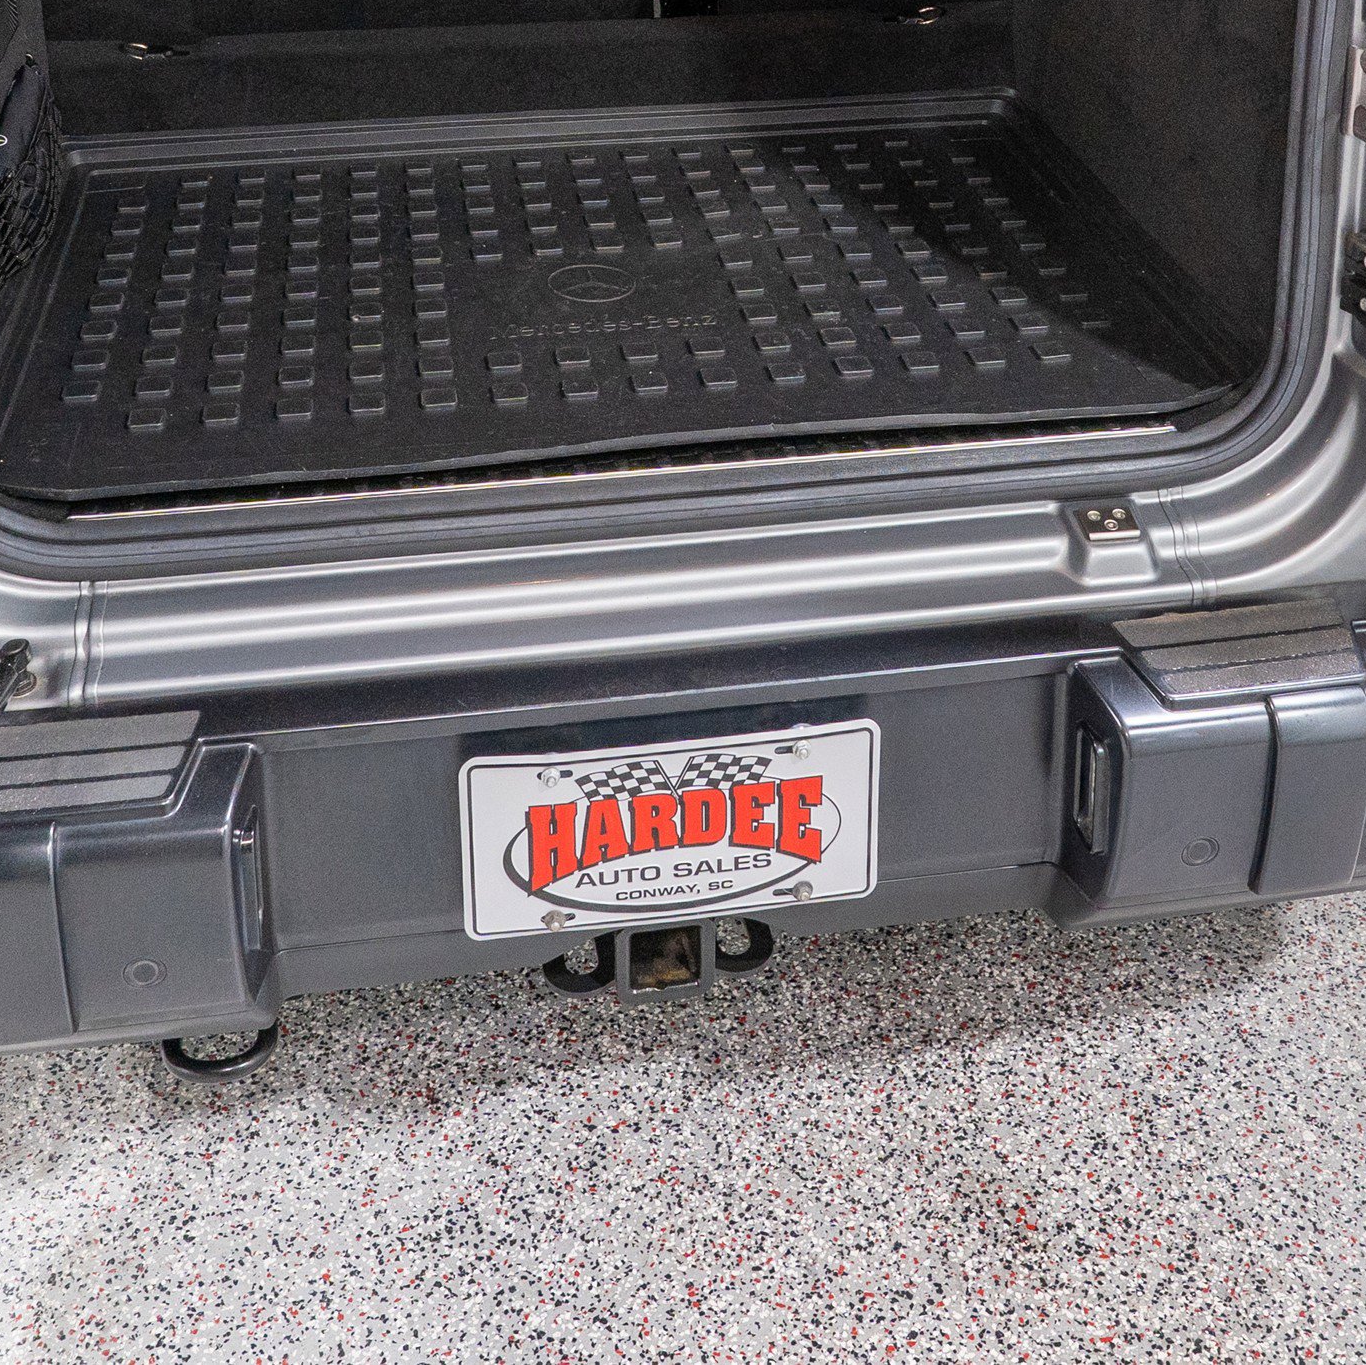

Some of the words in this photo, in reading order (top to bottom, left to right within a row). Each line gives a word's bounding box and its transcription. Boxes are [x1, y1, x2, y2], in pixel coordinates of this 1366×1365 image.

[525, 774, 823, 896] HARDEE
[575, 866, 661, 888] AUTO
[673, 852, 772, 878] SALES
[616, 883, 701, 901] CONWAY,
[708, 879, 734, 891] SC
